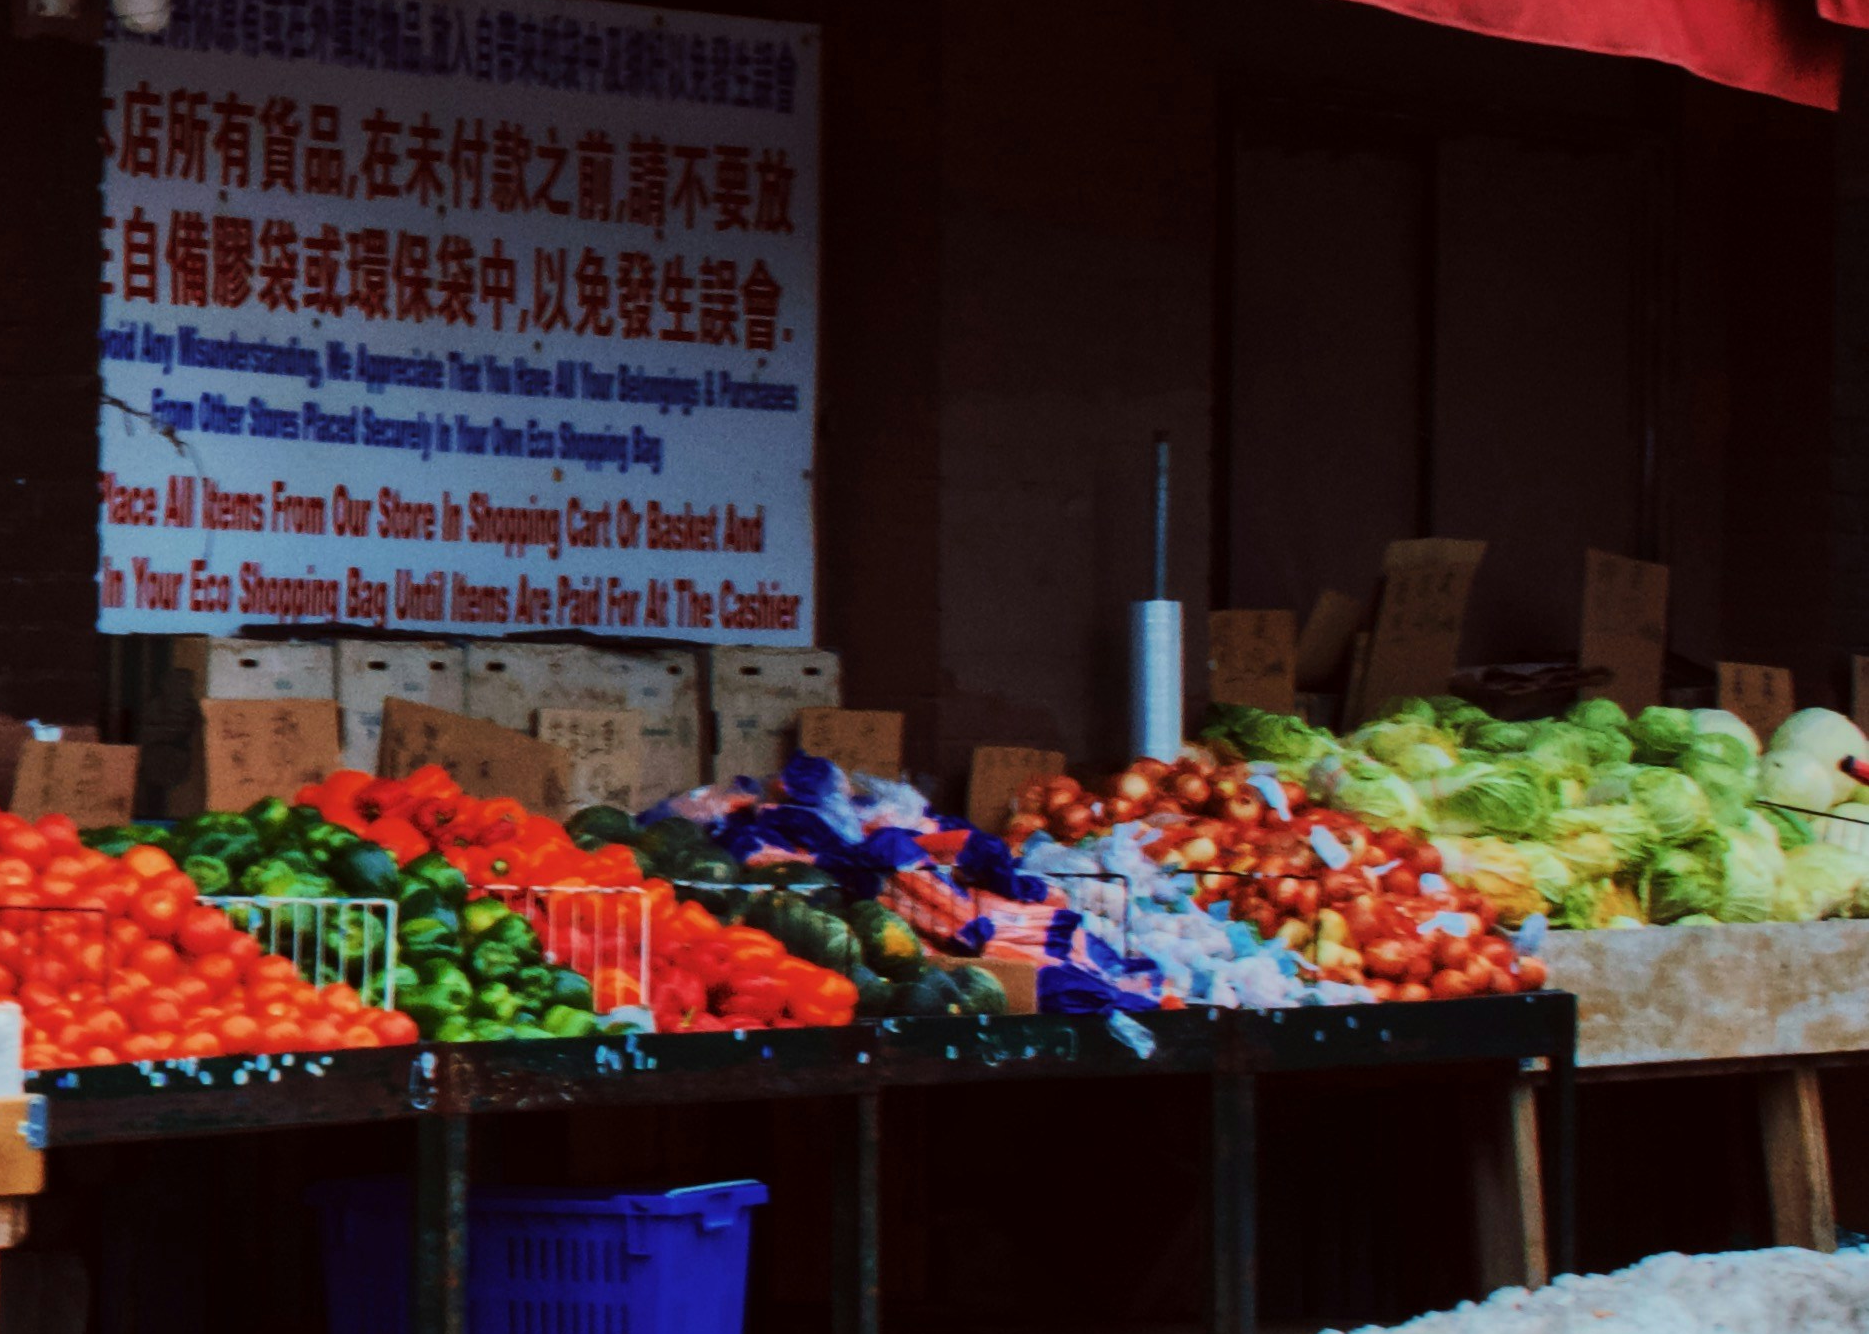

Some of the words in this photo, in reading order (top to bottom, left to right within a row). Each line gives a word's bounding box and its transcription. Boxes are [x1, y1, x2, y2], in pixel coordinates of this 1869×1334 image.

[164, 475, 195, 528] All
[202, 477, 264, 532] Items
[272, 480, 326, 536] From
[332, 484, 371, 537] Our
[378, 486, 436, 540] Store
[442, 490, 462, 542] In
[467, 491, 560, 560] Shopping
[566, 496, 611, 548] Cart
[616, 498, 641, 549] Or
[646, 500, 717, 552] Basket
[723, 503, 764, 554] And
[131, 557, 183, 611] Your
[190, 559, 230, 613] Eco
[238, 561, 339, 623] Shopping
[346, 566, 388, 629] Bag
[395, 569, 446, 622] Until
[451, 571, 509, 624] Items
[515, 573, 551, 626] Are
[557, 575, 602, 628] Paid
[607, 577, 640, 629] For
[644, 578, 668, 630] At
[673, 578, 713, 630] The
[720, 580, 802, 632] Cashier
